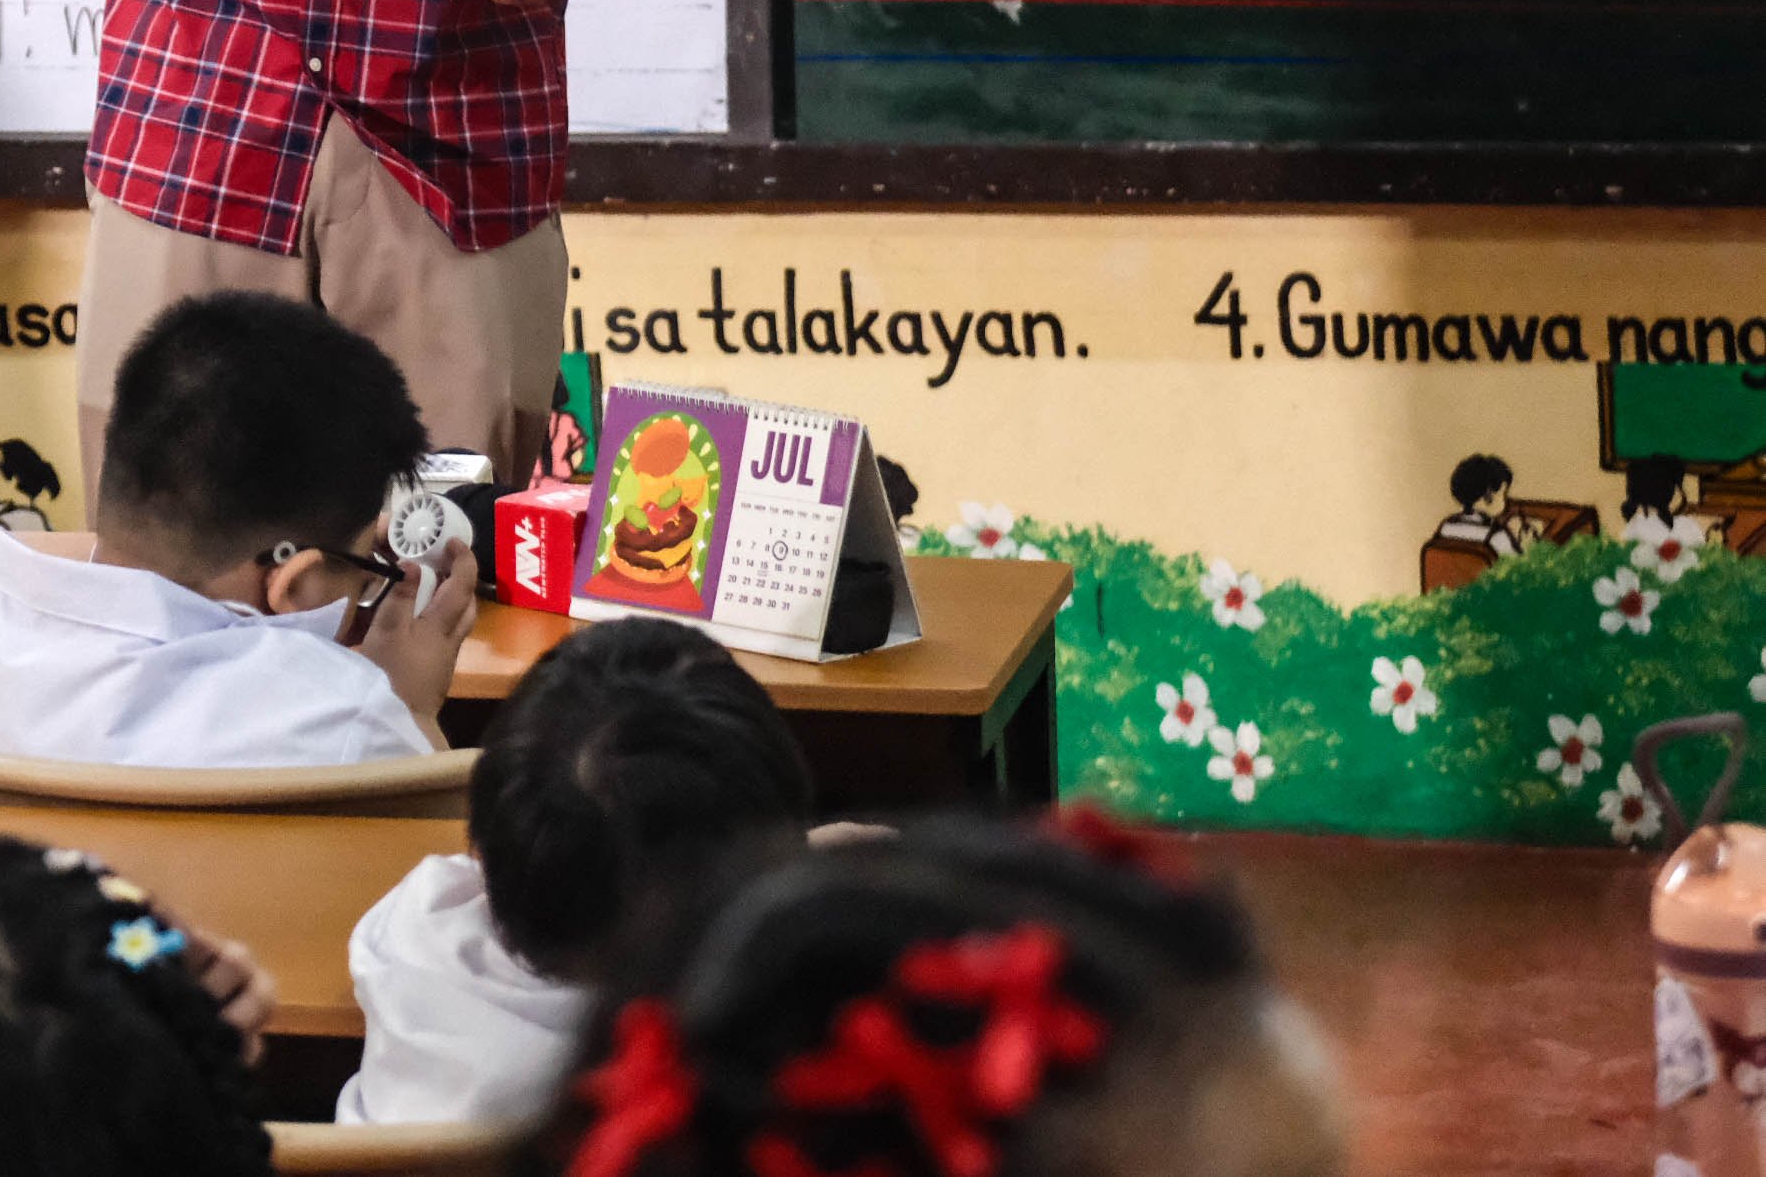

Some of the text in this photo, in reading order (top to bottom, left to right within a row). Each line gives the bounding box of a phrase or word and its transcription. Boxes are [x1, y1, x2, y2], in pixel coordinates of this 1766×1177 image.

[604, 306, 689, 356] sa
[697, 266, 1091, 390] talakayan.
[1277, 271, 1590, 363] Gumawa
[749, 430, 815, 487] JUL
[781, 528, 789, 538] 2
[795, 530, 802, 540] 3
[809, 534, 816, 542] 4
[823, 534, 829, 545] 5
[735, 538, 828, 561] 6 7 8 9 10 11 12
[732, 557, 740, 565] 13
[746, 559, 754, 567] 14
[761, 561, 768, 570] 15
[775, 563, 782, 571] 16
[803, 567, 810, 576] 18
[817, 570, 824, 579] 19
[728, 575, 737, 583] 20
[742, 576, 751, 585] 21
[756, 579, 766, 588] 22
[770, 581, 780, 590] 23
[798, 585, 808, 595] 25
[812, 589, 822, 597] 26
[724, 593, 790, 610] 27 28 29 30 31
